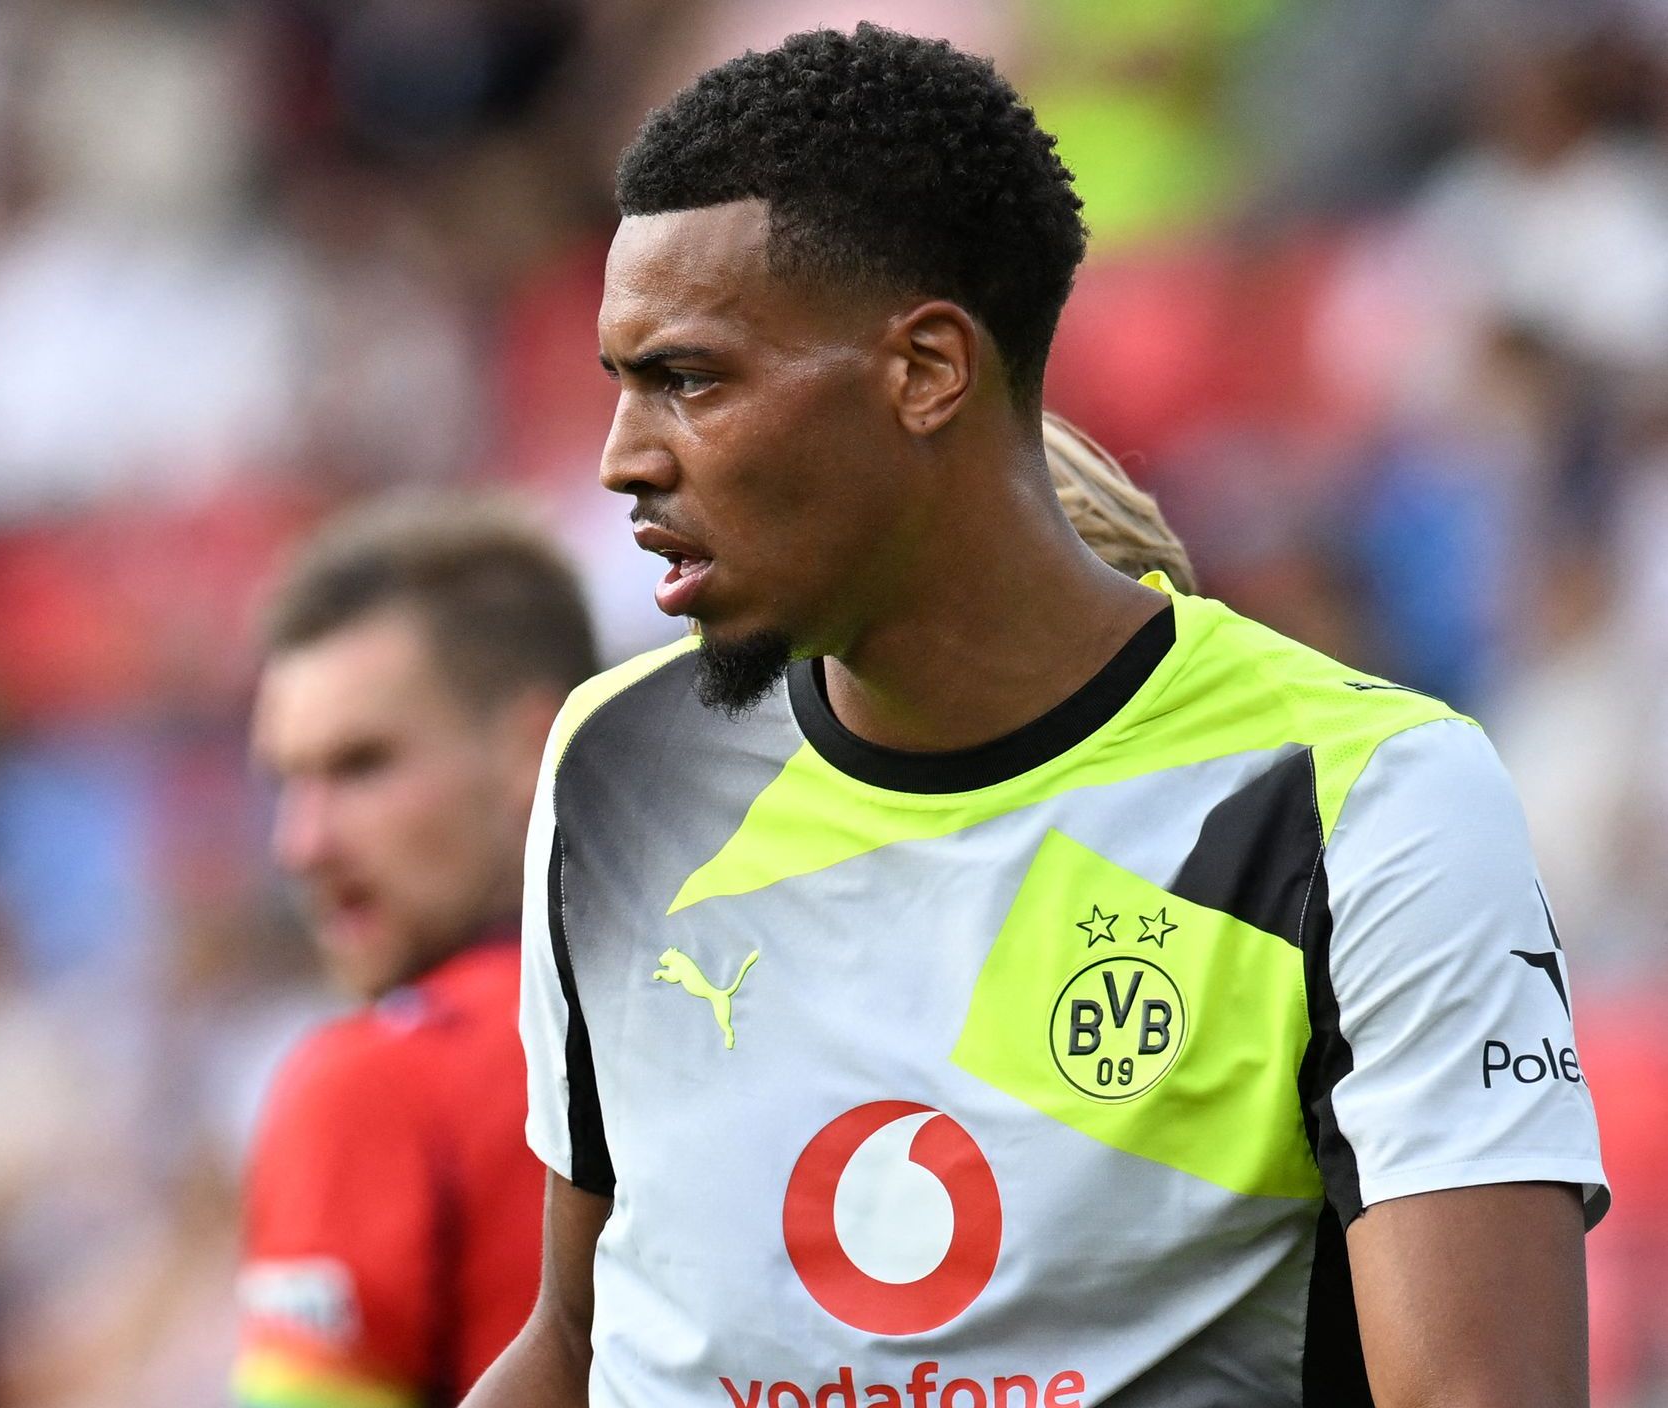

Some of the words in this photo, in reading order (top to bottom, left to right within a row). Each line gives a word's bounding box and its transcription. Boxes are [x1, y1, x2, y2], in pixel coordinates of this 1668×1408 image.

[1068, 970, 1173, 1057] BVB
[1096, 1056, 1134, 1087] 09
[1483, 1037, 1588, 1088] Pole
